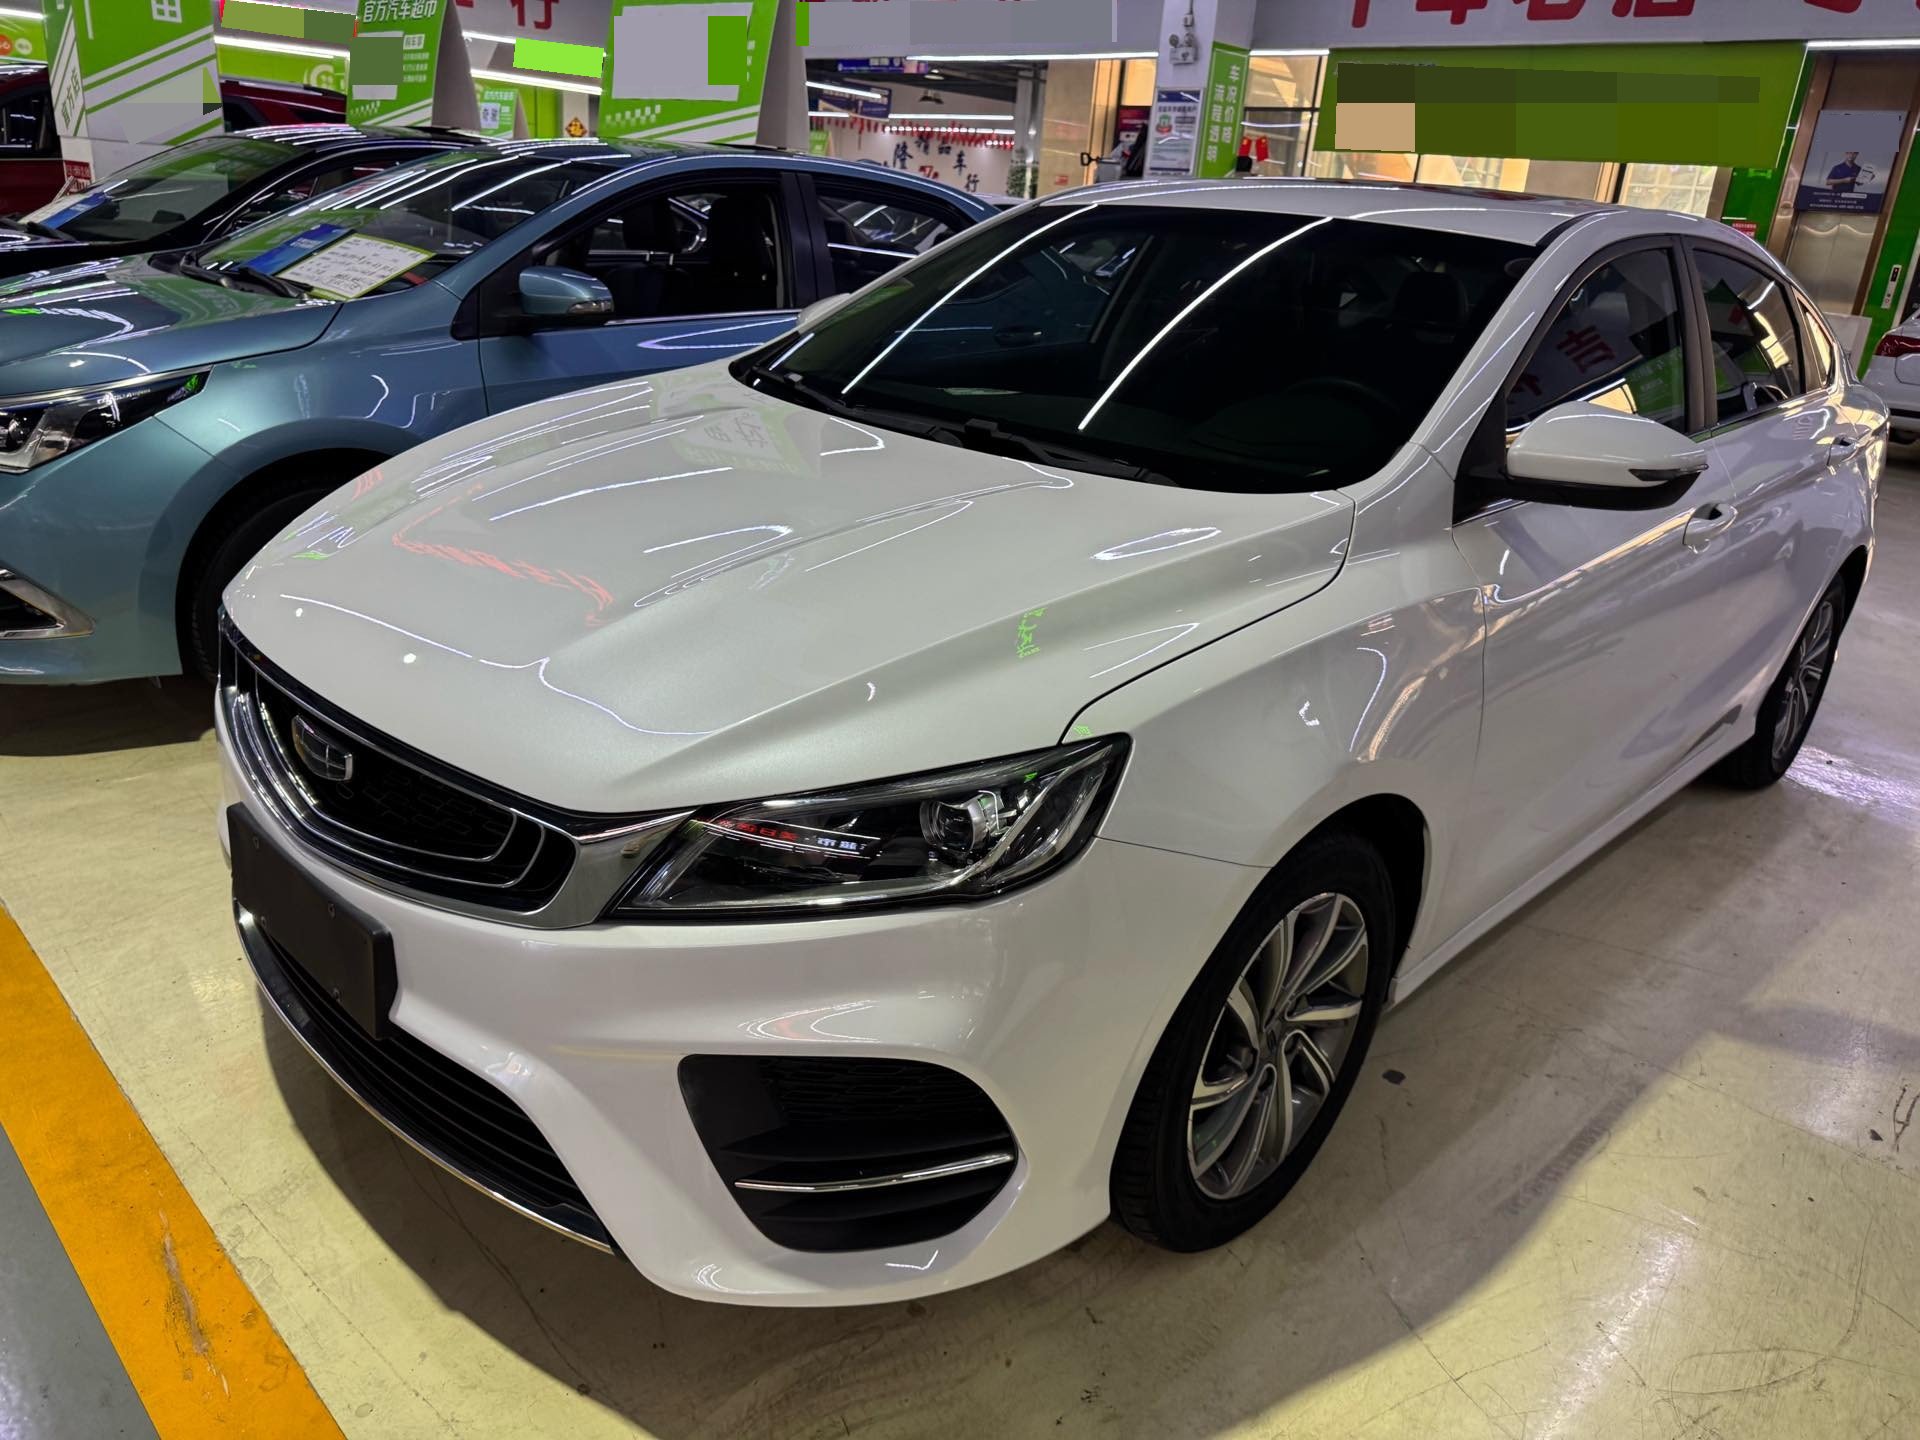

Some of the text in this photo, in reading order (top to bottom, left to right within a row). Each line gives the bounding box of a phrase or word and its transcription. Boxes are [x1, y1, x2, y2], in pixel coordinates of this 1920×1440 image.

[363, 0, 437, 23] 官方汽车超市
